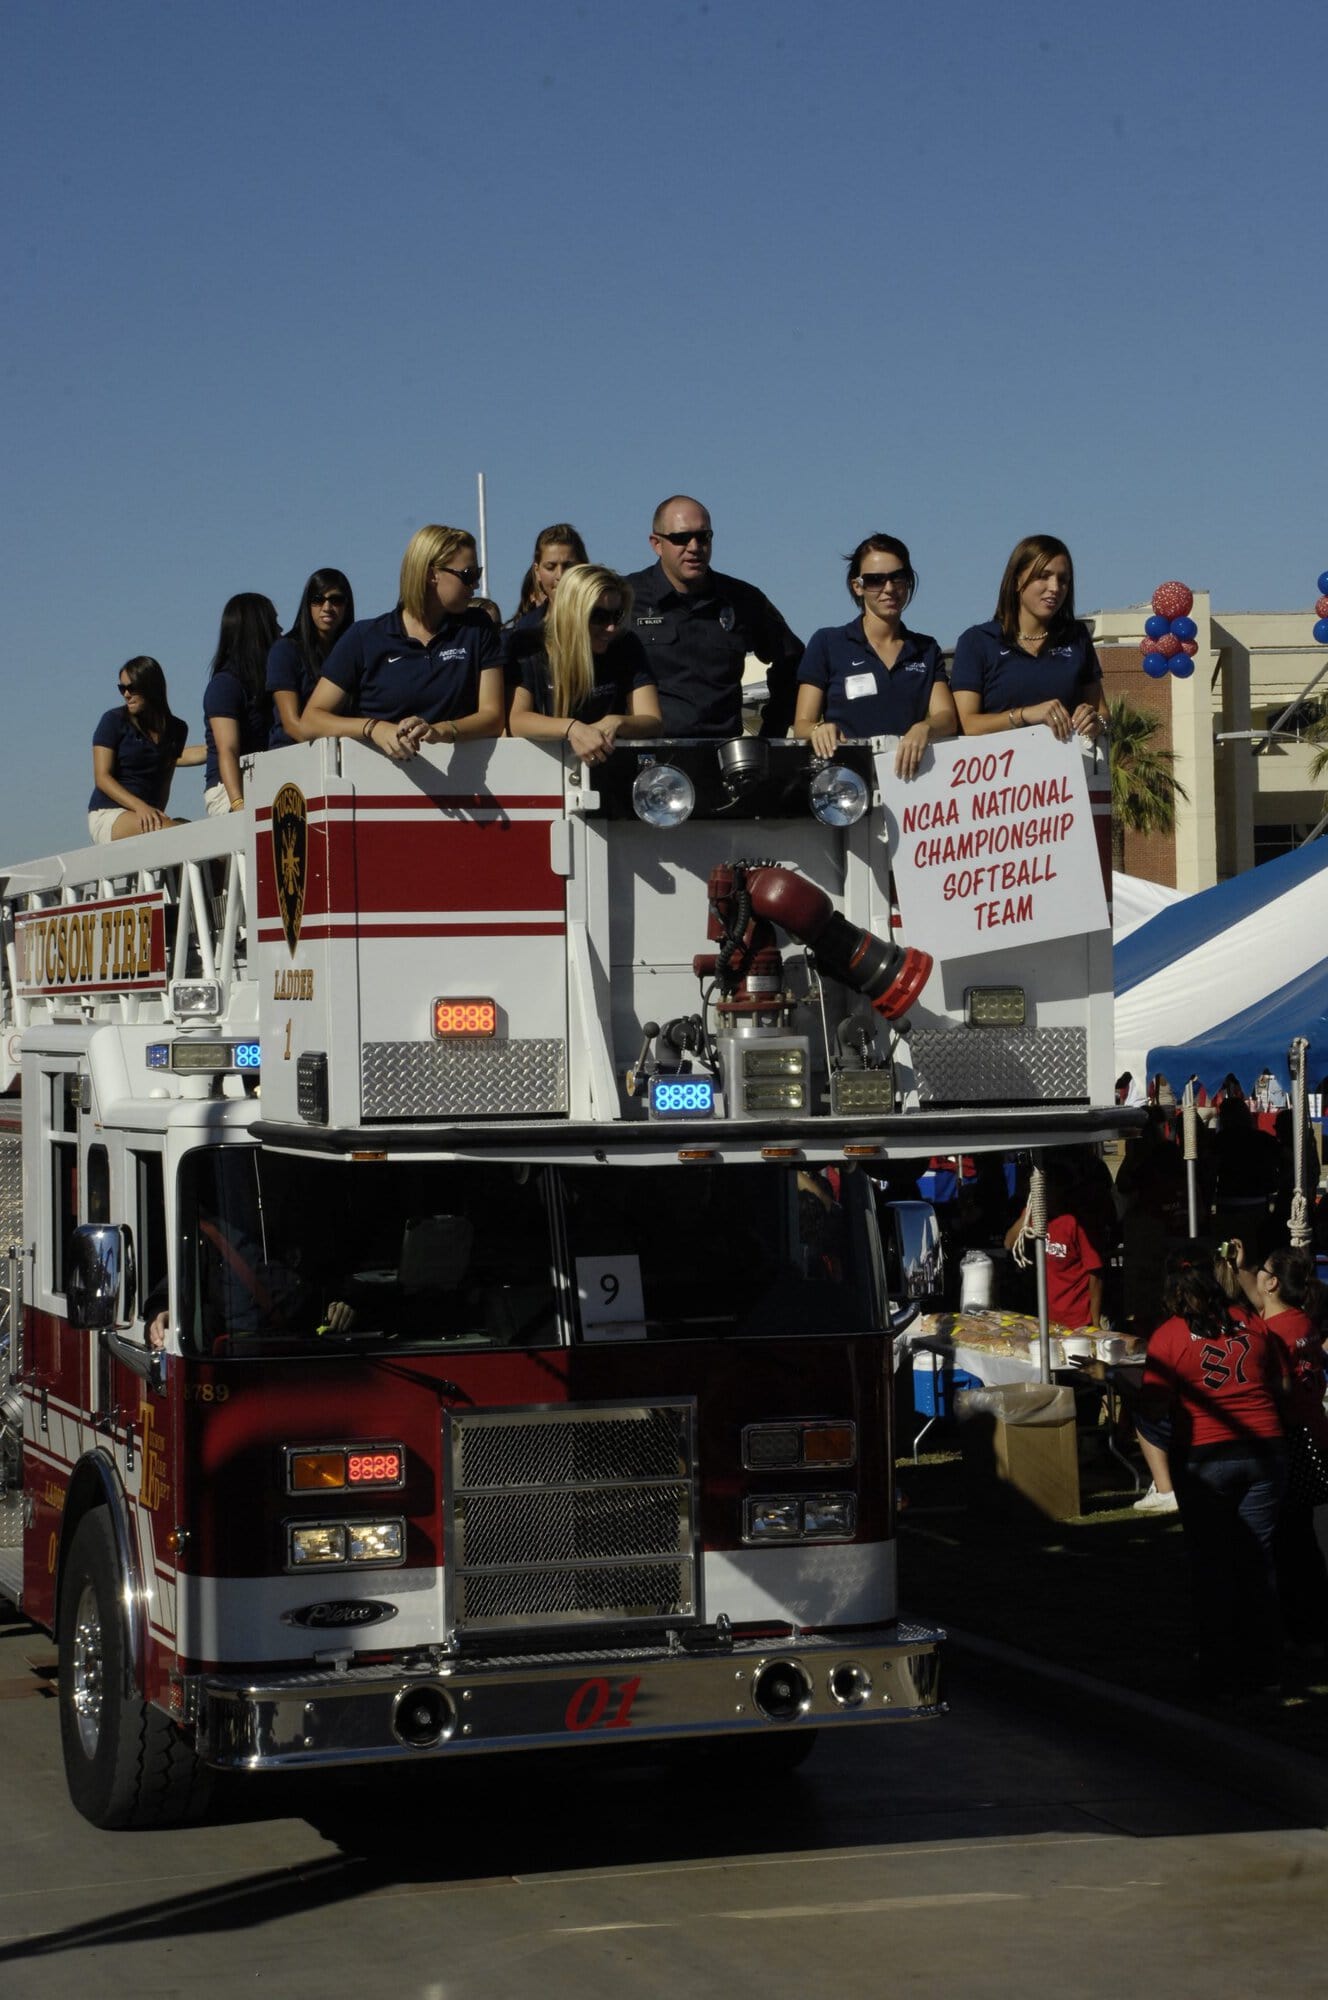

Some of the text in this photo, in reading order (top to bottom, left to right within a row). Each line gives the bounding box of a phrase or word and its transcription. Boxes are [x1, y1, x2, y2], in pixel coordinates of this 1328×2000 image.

[950, 749, 1015, 788] 2007
[903, 776, 1074, 834] NCAA NATIONAL
[914, 813, 1074, 869] CHAMPIONSHIP
[943, 854, 1057, 901] SOFTBALL
[974, 894, 1033, 931] TEAM
[25, 906, 152, 985] TUCSON FIRE
[273, 969, 314, 1001] LADDER
[600, 1273, 620, 1305] 9
[306, 1604, 370, 1626] Pierce
[565, 1673, 643, 1733] 01
